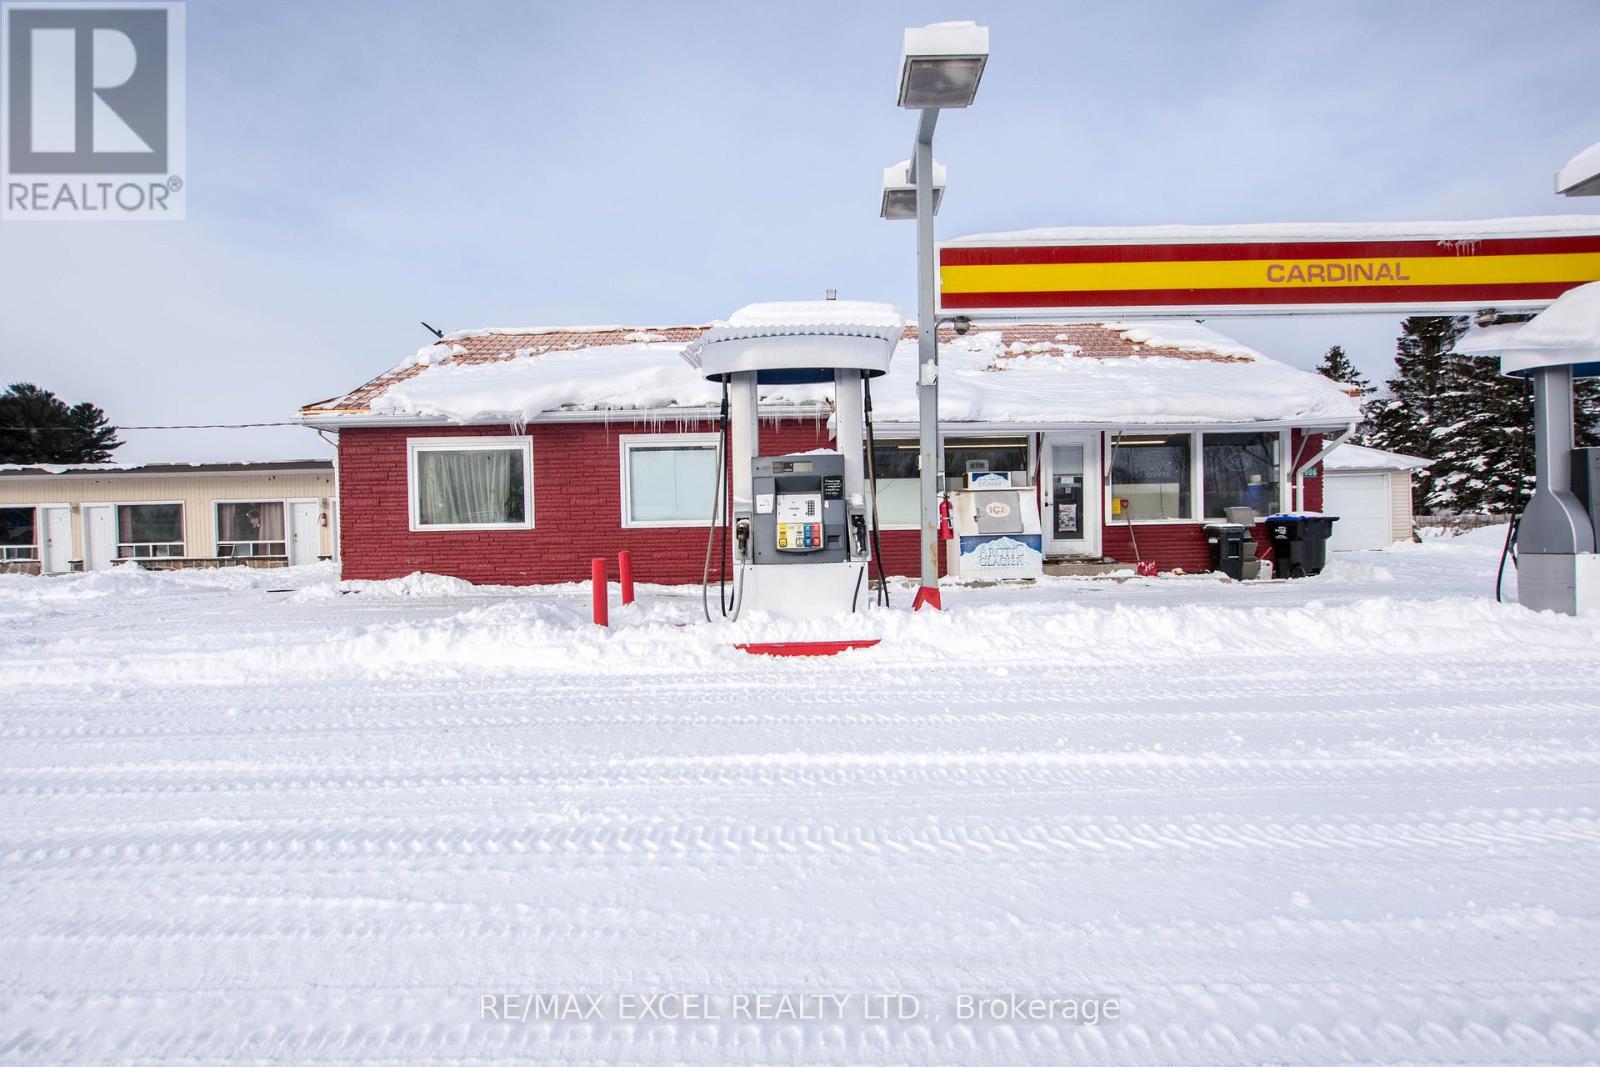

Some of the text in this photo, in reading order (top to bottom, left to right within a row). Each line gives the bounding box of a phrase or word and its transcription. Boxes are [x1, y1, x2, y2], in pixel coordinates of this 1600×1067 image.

[1266, 262, 1410, 283] CARDINAL
[979, 544, 1025, 558] ARCTIC
[979, 557, 1025, 567] GLACIER
